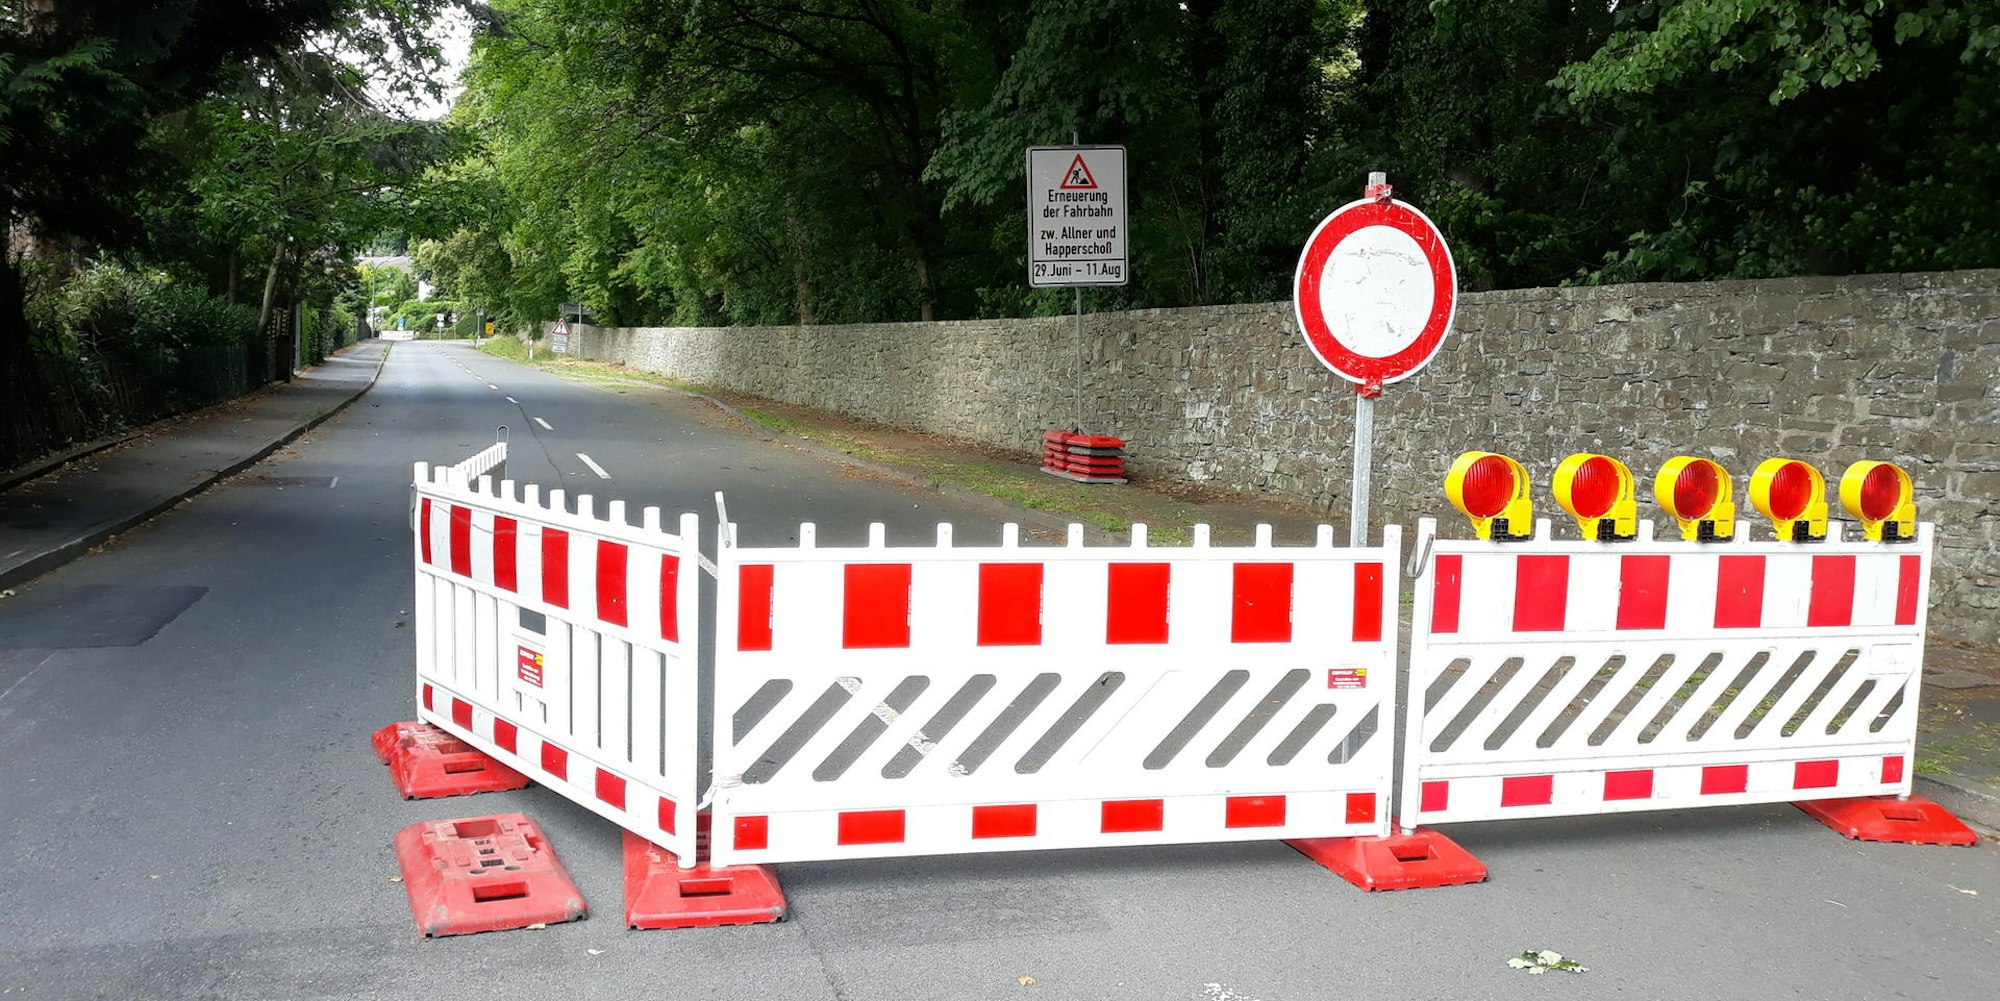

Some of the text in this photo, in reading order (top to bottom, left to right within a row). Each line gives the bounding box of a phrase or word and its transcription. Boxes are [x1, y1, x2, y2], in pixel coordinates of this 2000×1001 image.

[1048, 189, 1108, 205] Erneuerung
[1043, 205, 1113, 218] der Fahrbahn
[1040, 226, 1116, 240] zw. Allner und
[1045, 242, 1112, 258] Happerschoß
[1035, 263, 1072, 277] 29.Juni
[1086, 263, 1121, 278] 11.Aug
